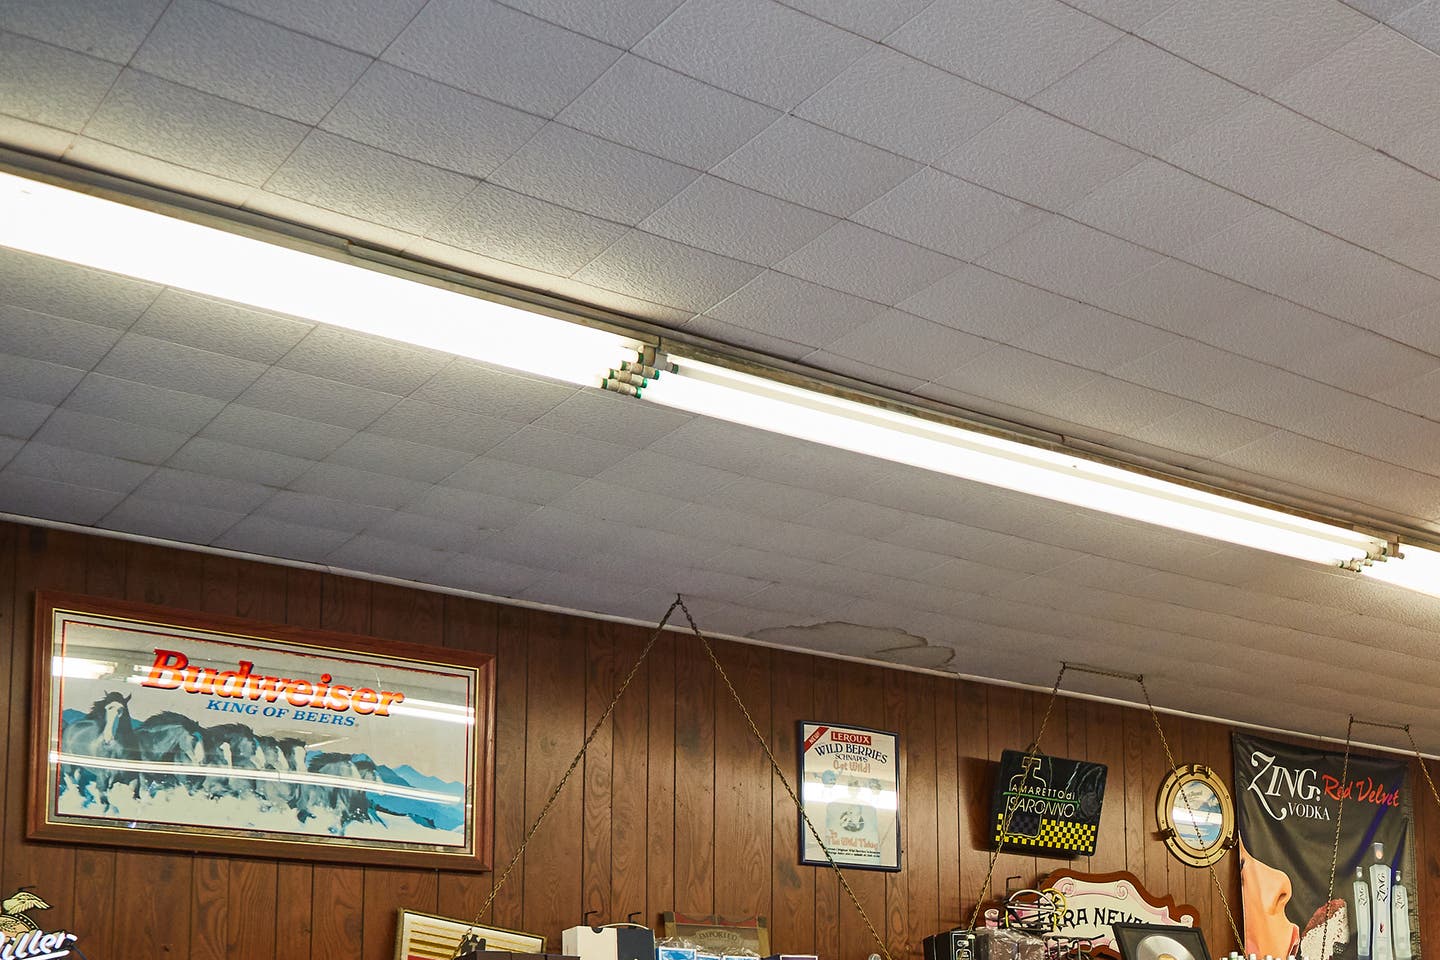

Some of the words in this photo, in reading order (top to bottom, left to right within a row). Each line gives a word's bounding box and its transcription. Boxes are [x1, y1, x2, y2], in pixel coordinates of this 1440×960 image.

[141, 647, 405, 717] Budweiser
[205, 699, 259, 717] KING
[262, 705, 288, 719] OF
[292, 708, 355, 727] BEERS
[832, 732, 871, 744] LEROUX
[815, 743, 843, 757] WILD
[847, 744, 888, 764] BERRIES
[835, 754, 868, 762] SCHNAPPS
[1012, 784, 1064, 799] AMARETTO
[1322, 774, 1352, 801] Red
[1355, 777, 1400, 807] Velvet
[1009, 795, 1075, 818] SARONNO
[1288, 802, 1331, 821] VODKA
